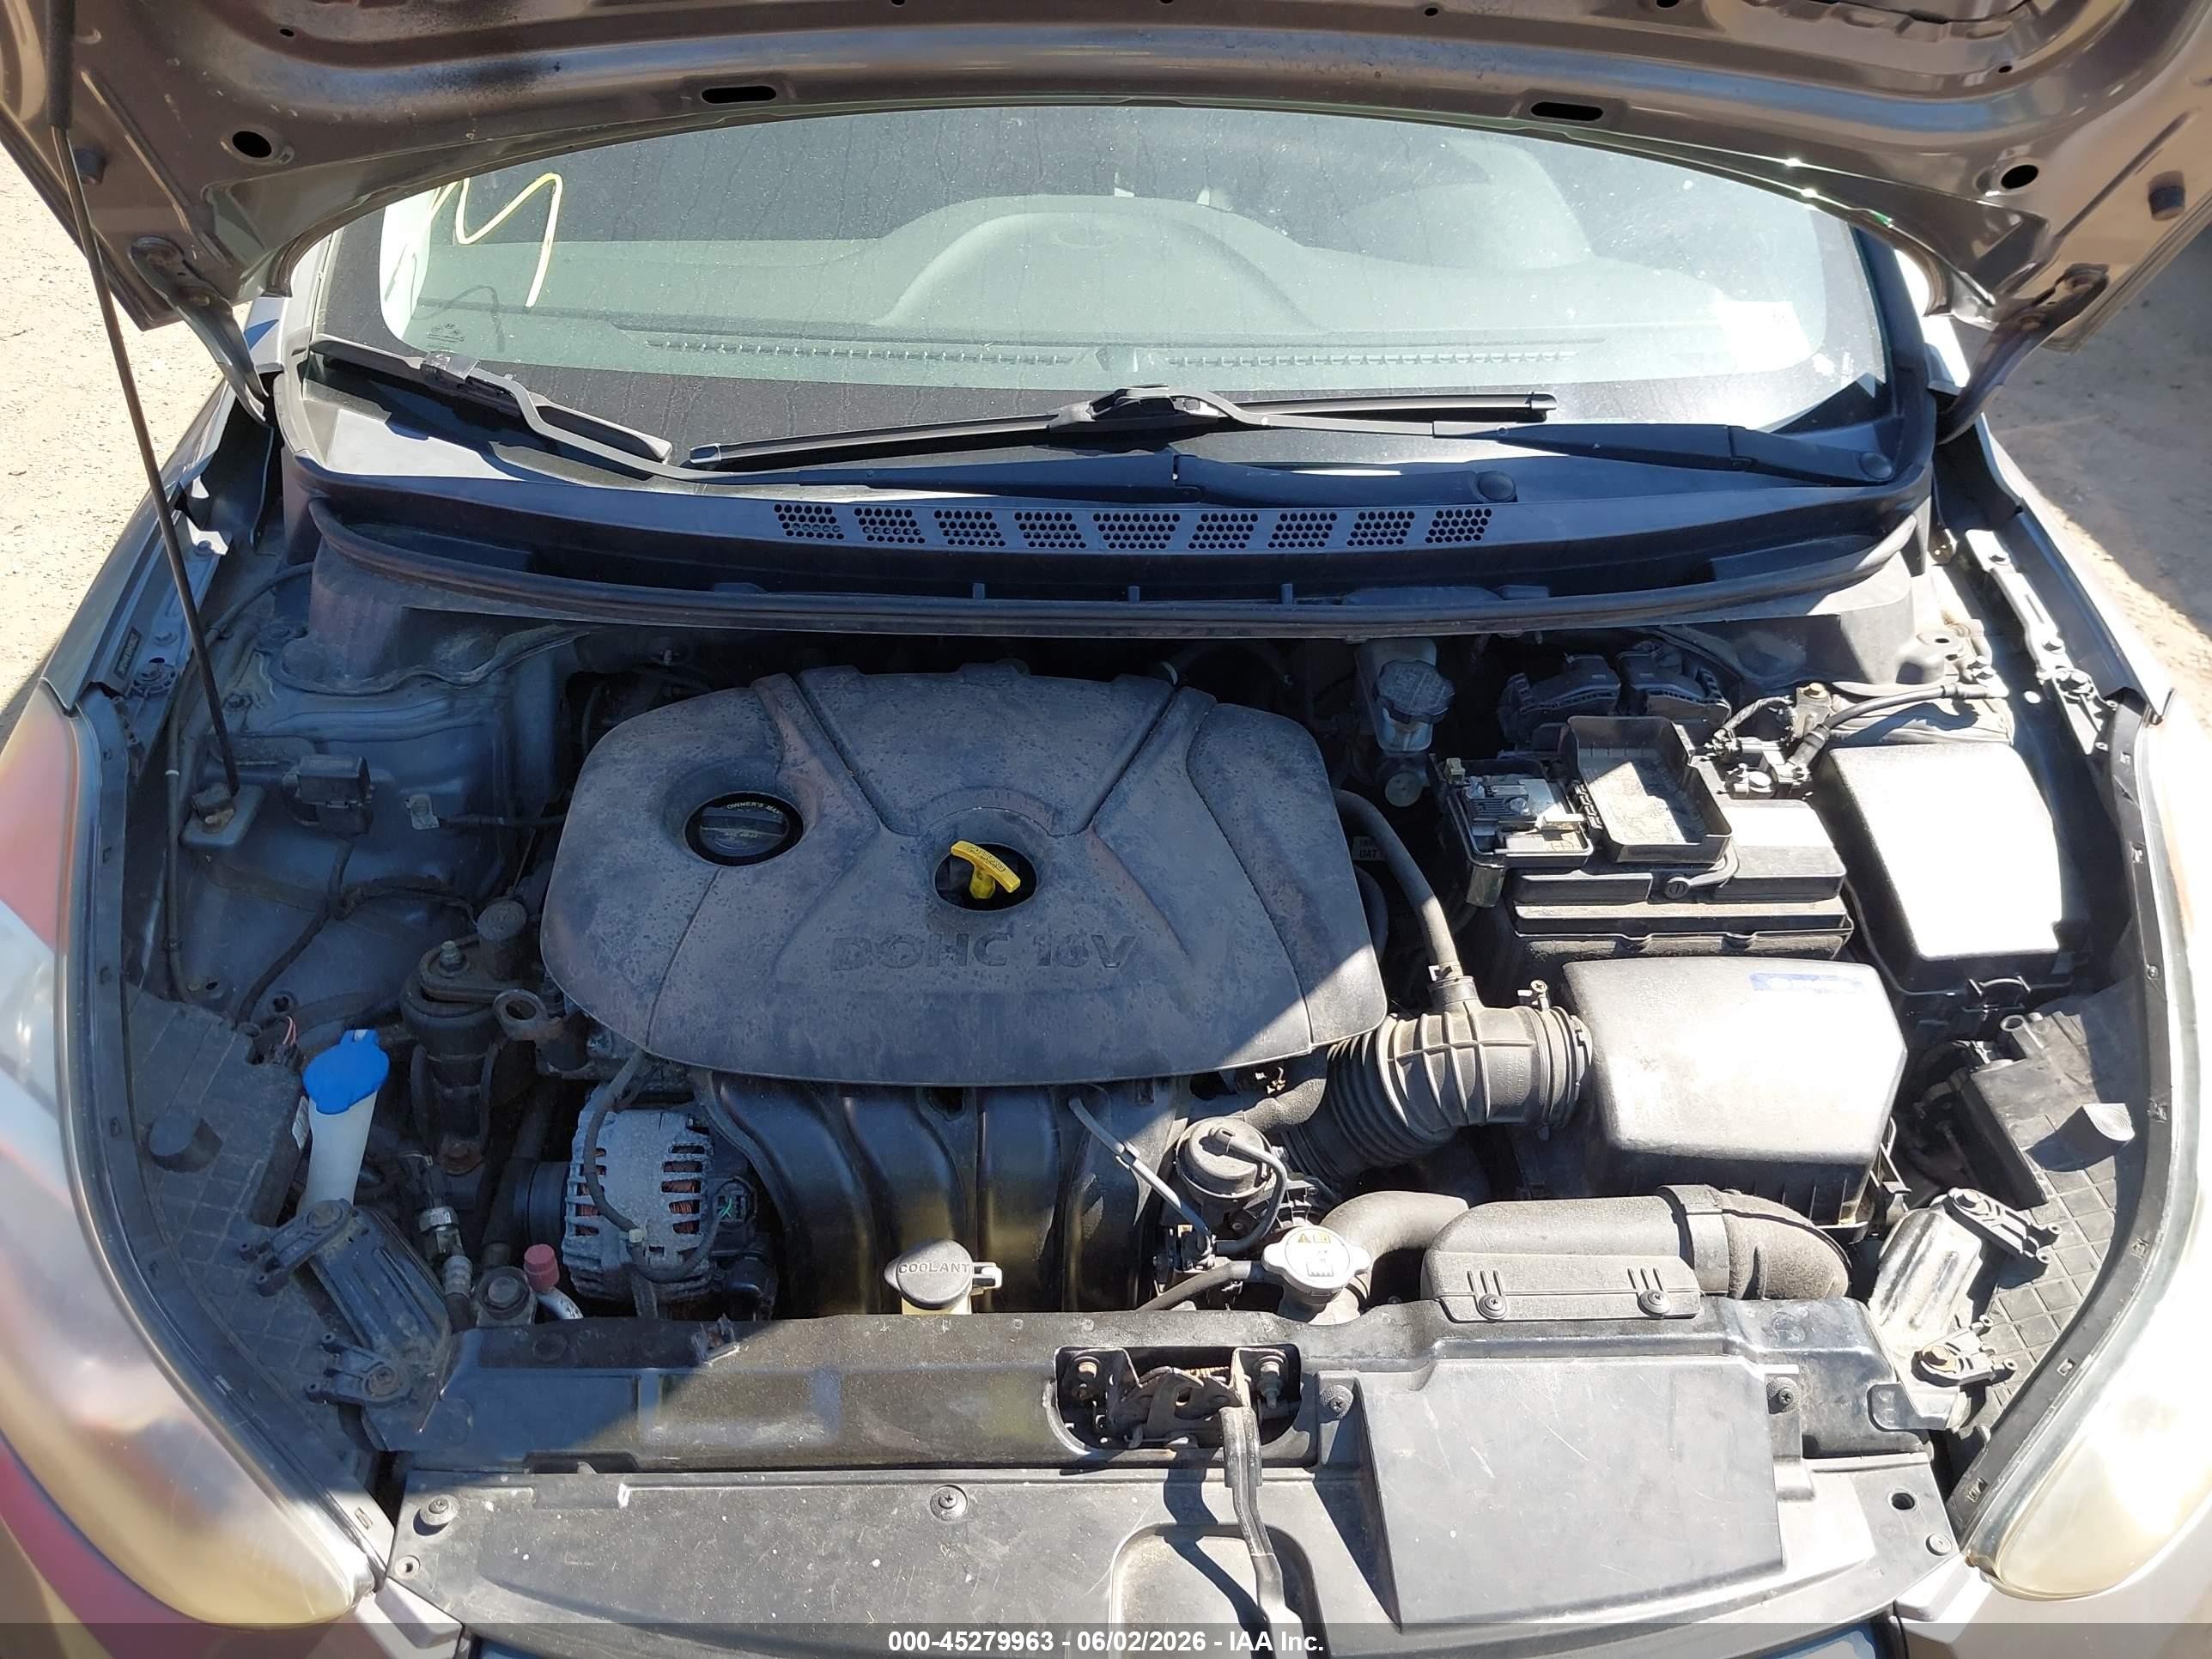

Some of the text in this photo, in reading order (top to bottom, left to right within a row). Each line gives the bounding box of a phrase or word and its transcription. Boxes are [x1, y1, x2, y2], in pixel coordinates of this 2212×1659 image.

[726, 801, 764, 810] OWNER'S
[830, 933, 1136, 971] DOHC 16V
[898, 1262, 970, 1274] COOLANT
